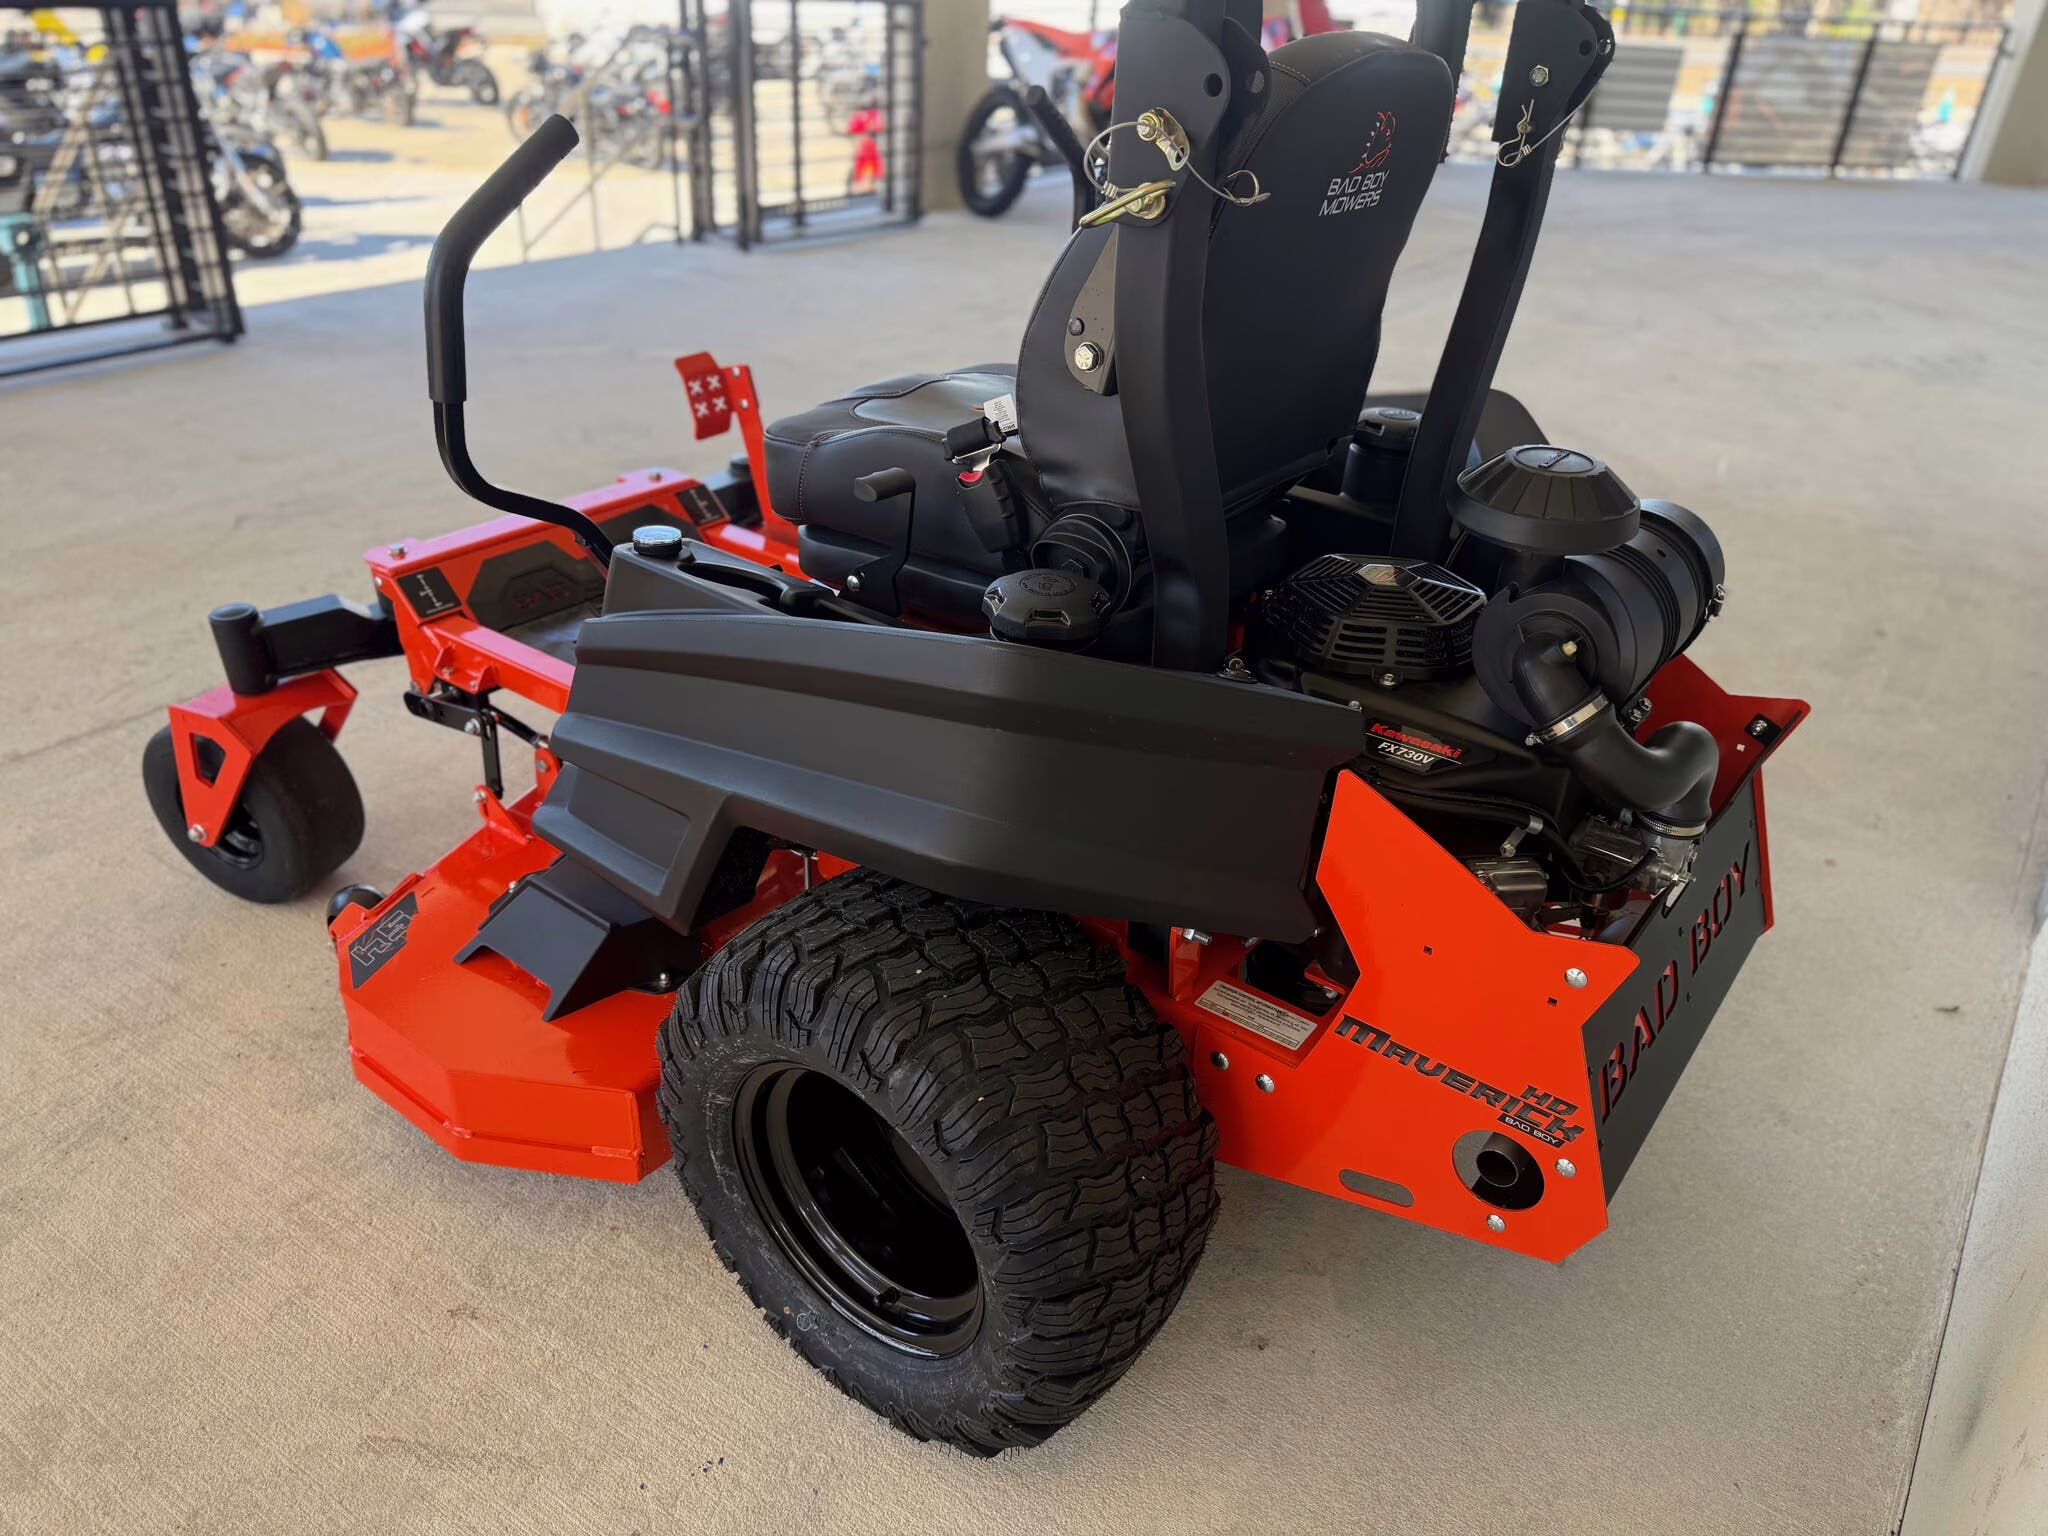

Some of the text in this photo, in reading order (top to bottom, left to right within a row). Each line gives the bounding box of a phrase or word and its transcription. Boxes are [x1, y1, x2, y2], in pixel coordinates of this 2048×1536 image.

[1327, 170, 1390, 196] BAD BOY
[1318, 189, 1382, 217] MOWERS
[1370, 723, 1462, 759] Kawasaki
[1377, 741, 1436, 764] FX730V
[1599, 840, 1750, 1124] BAD BOY
[1334, 1014, 1584, 1142] MAVERICK
[1520, 1084, 1579, 1115] HD
[1505, 1116, 1559, 1144] BAD BOY
